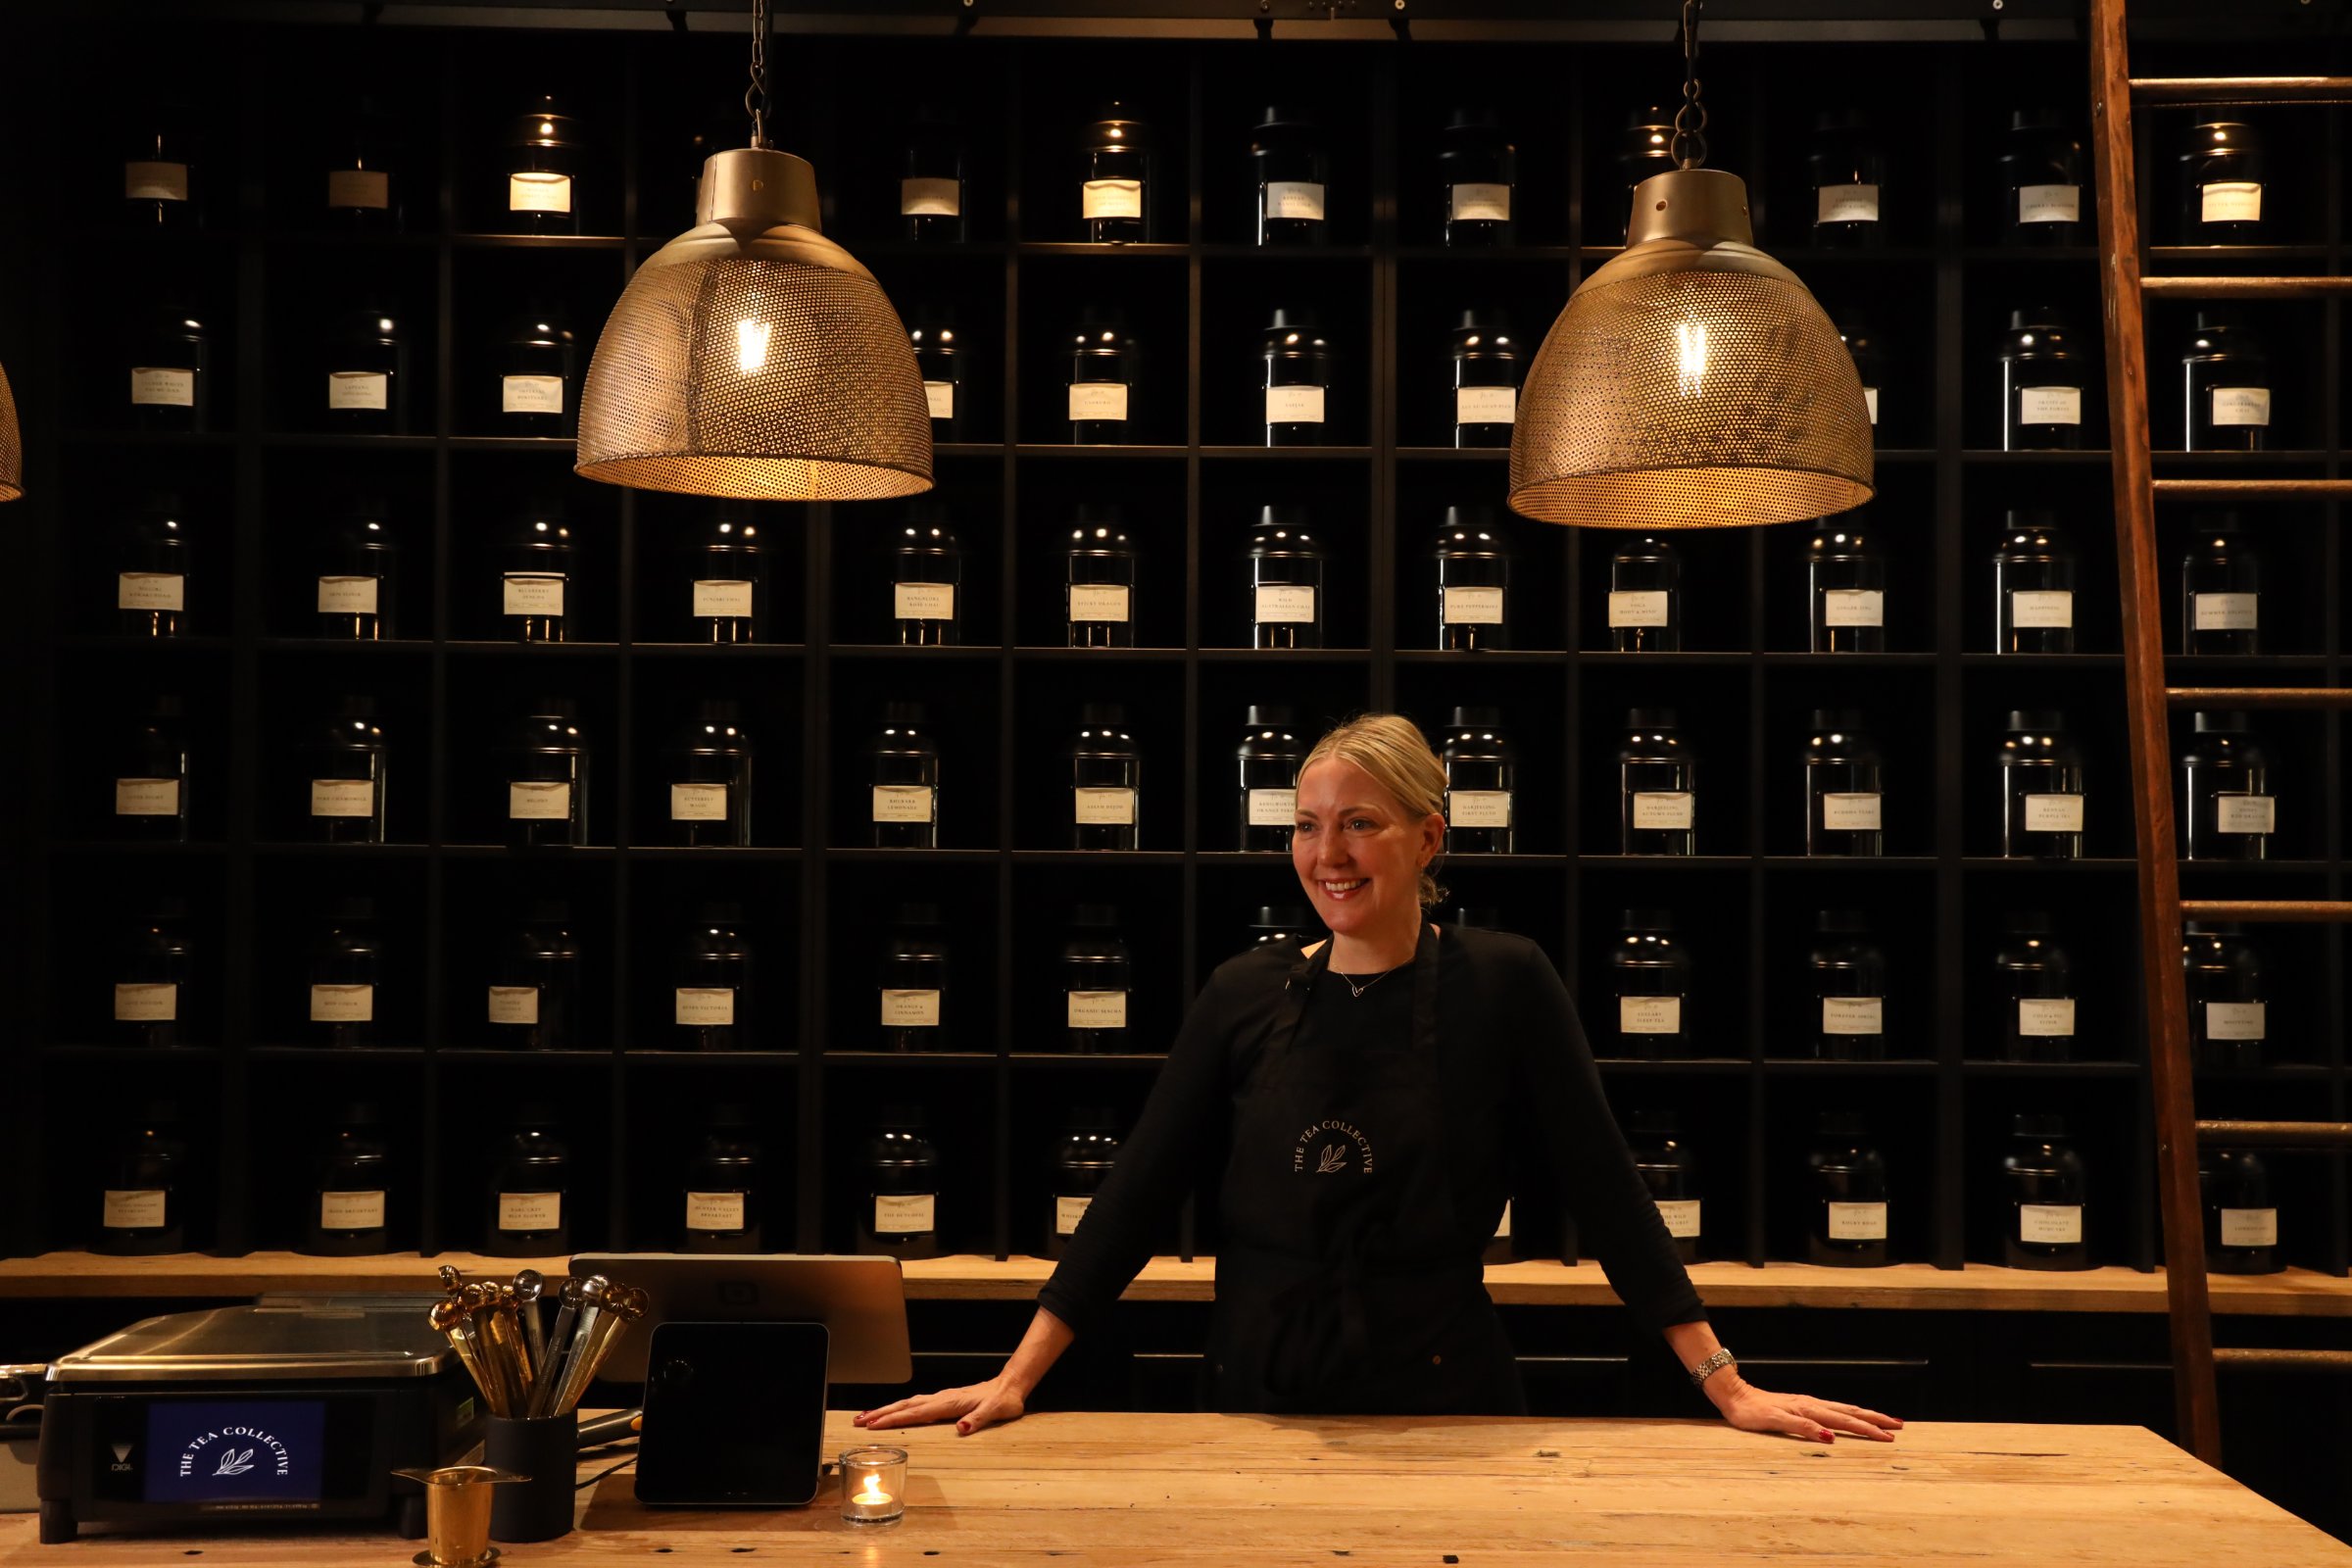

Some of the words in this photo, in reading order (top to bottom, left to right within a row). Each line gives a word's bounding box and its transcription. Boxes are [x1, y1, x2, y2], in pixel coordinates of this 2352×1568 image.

[1299, 1125, 1320, 1144] TEA
[1322, 1120, 1373, 1174] COLLECTIVE
[1295, 1147, 1304, 1172] THE
[179, 1452, 195, 1477] THE
[188, 1432, 219, 1450] TEA
[222, 1426, 289, 1476] COLLECTIVE
